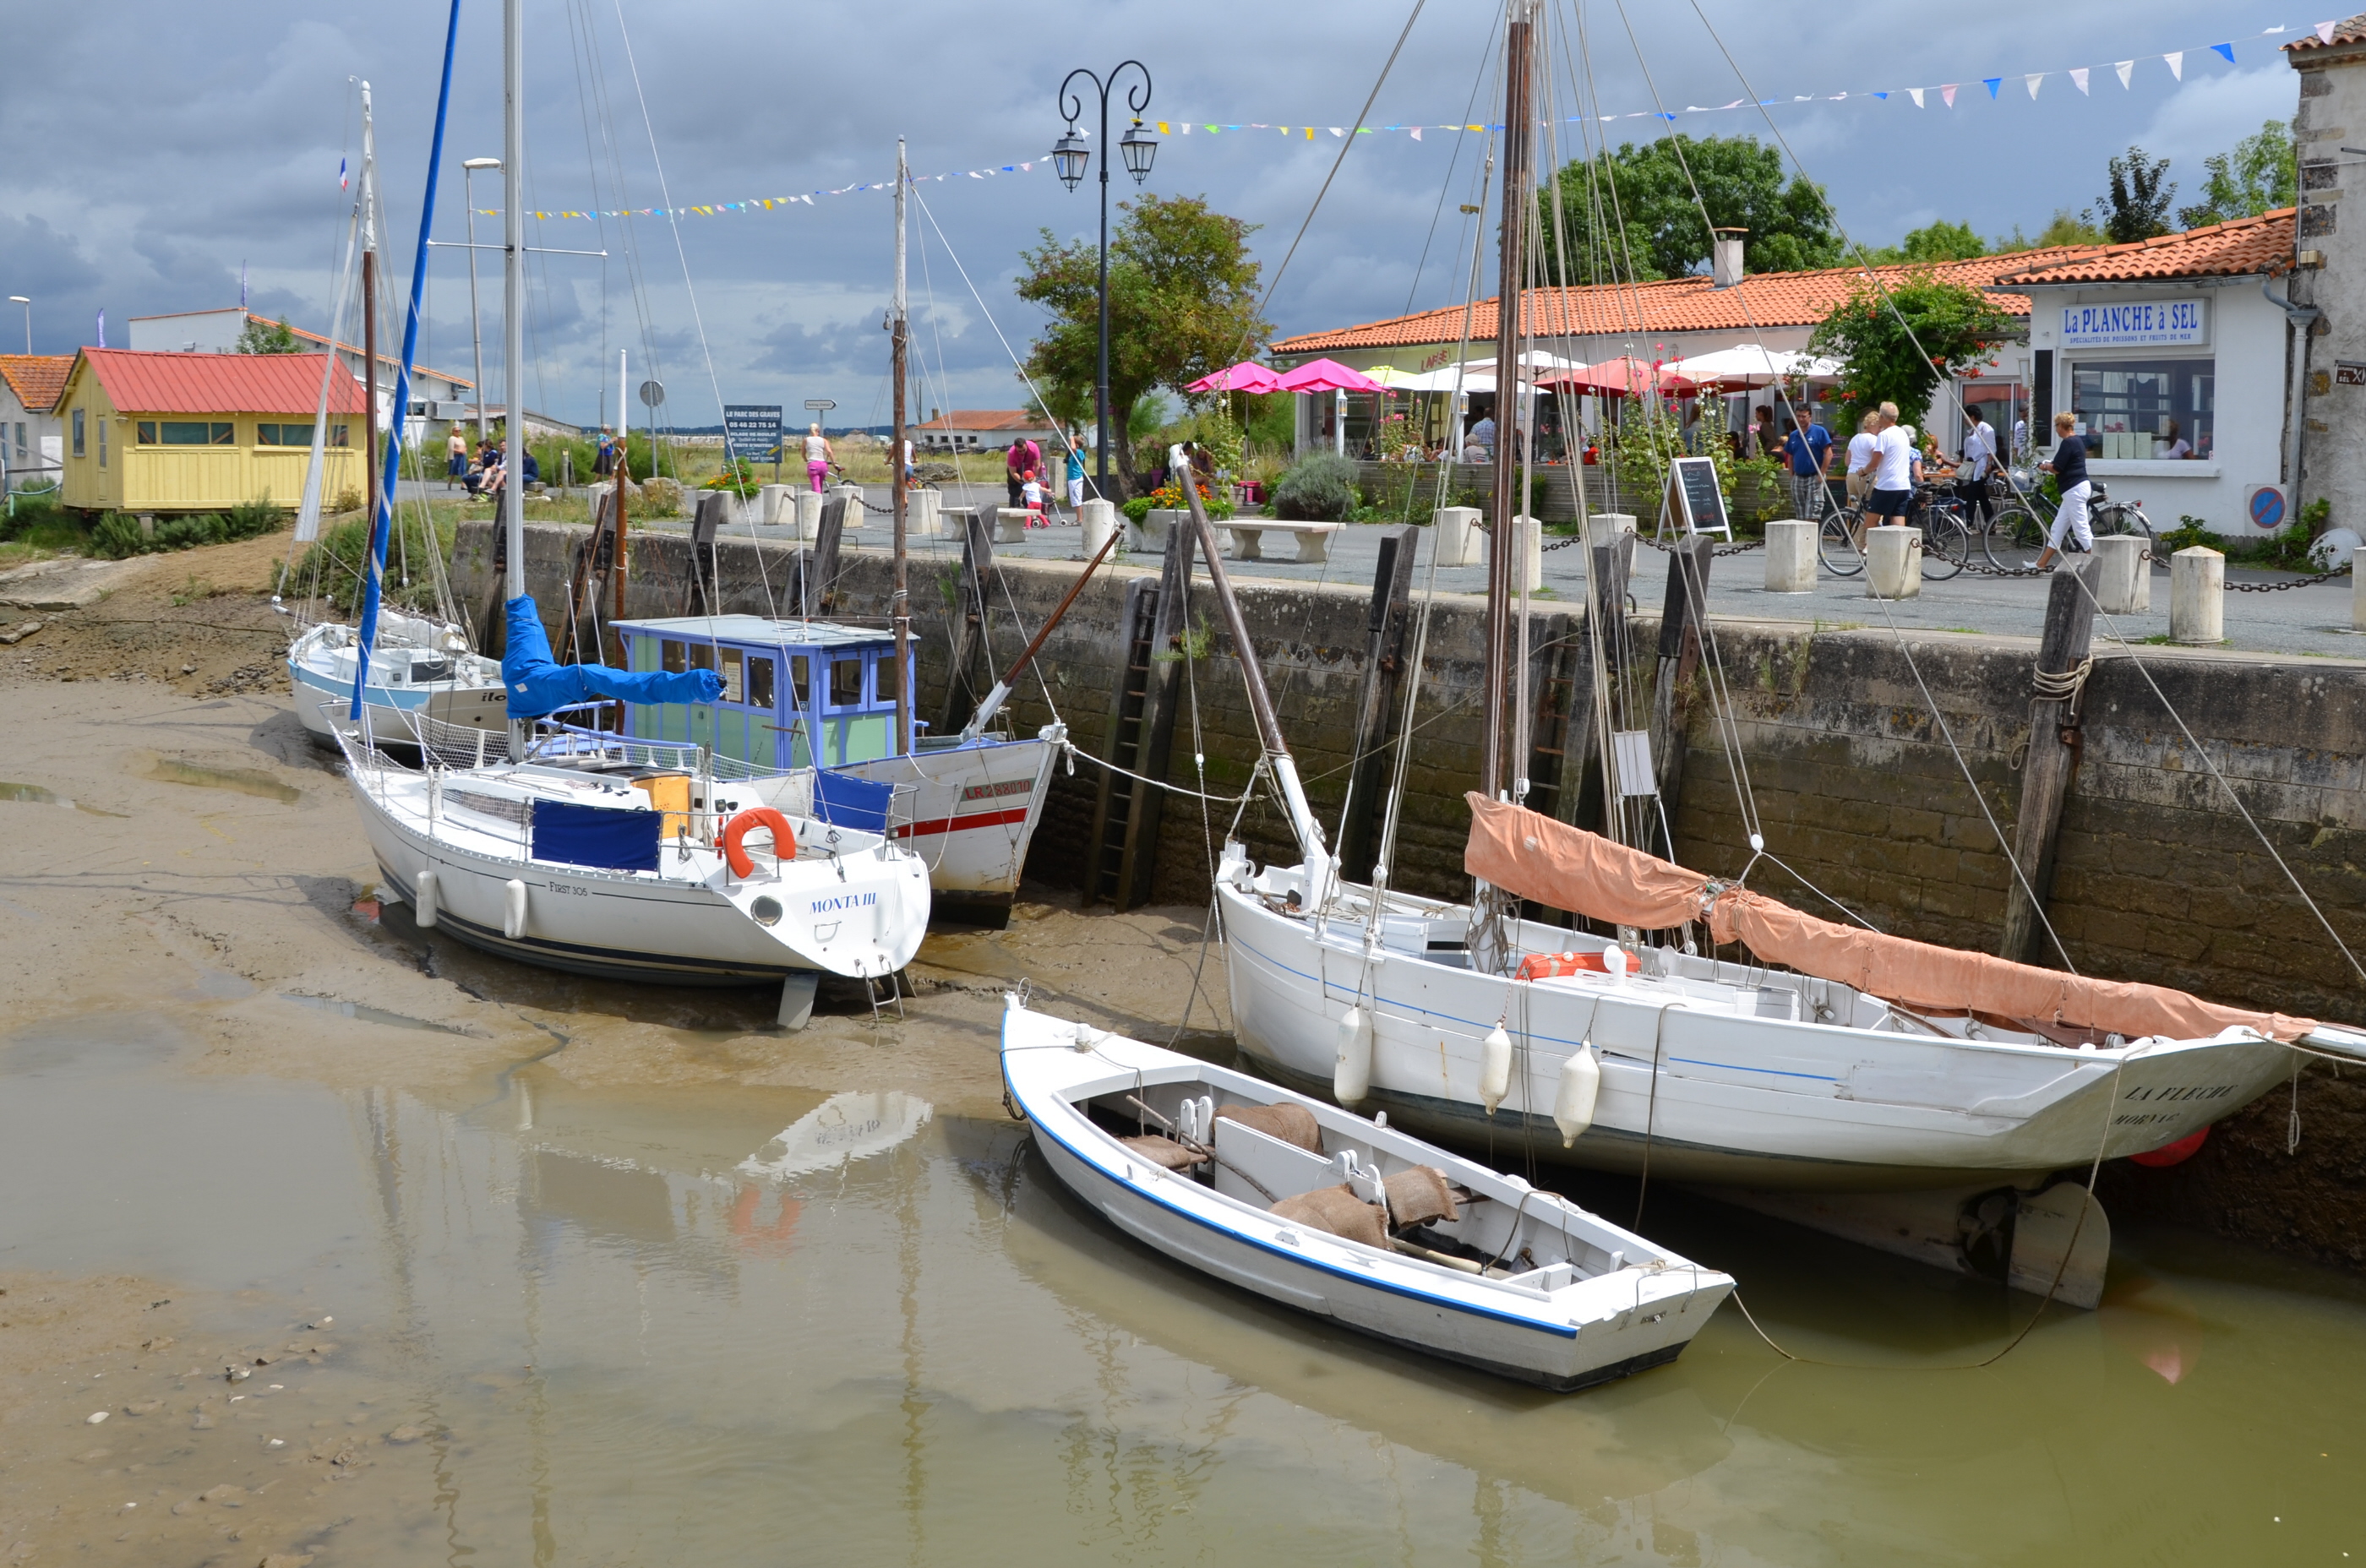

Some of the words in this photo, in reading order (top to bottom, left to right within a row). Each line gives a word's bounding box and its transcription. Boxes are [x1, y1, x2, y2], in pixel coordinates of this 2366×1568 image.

[2064, 309, 2078, 334] La
[2082, 306, 2152, 333] PLANCHE
[2159, 305, 2165, 330] à
[2172, 303, 2197, 329] SEL
[965, 787, 985, 800] LR
[986, 780, 1031, 798] 288010
[572, 886, 588, 896] 305
[810, 894, 859, 915] MONTA
[863, 892, 876, 906] III
[2124, 1086, 2154, 1101] LA
